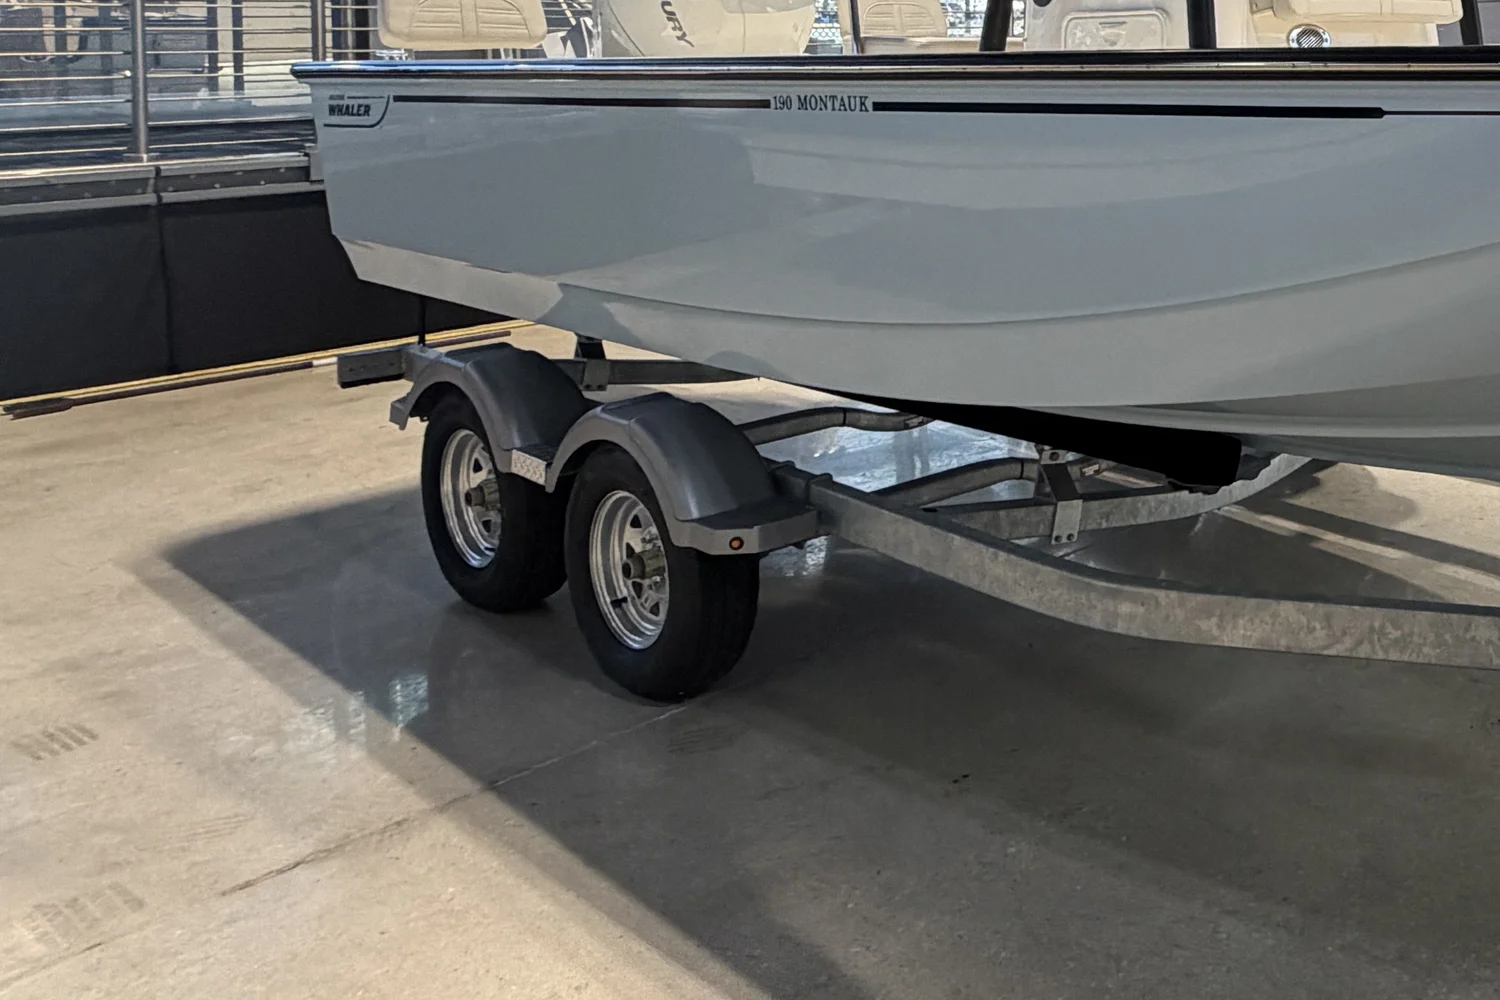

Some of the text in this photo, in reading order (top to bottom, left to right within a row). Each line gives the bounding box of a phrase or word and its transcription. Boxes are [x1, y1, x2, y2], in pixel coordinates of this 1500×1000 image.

[328, 103, 371, 117] WHALER
[773, 94, 870, 112] 190 MONTAUK
